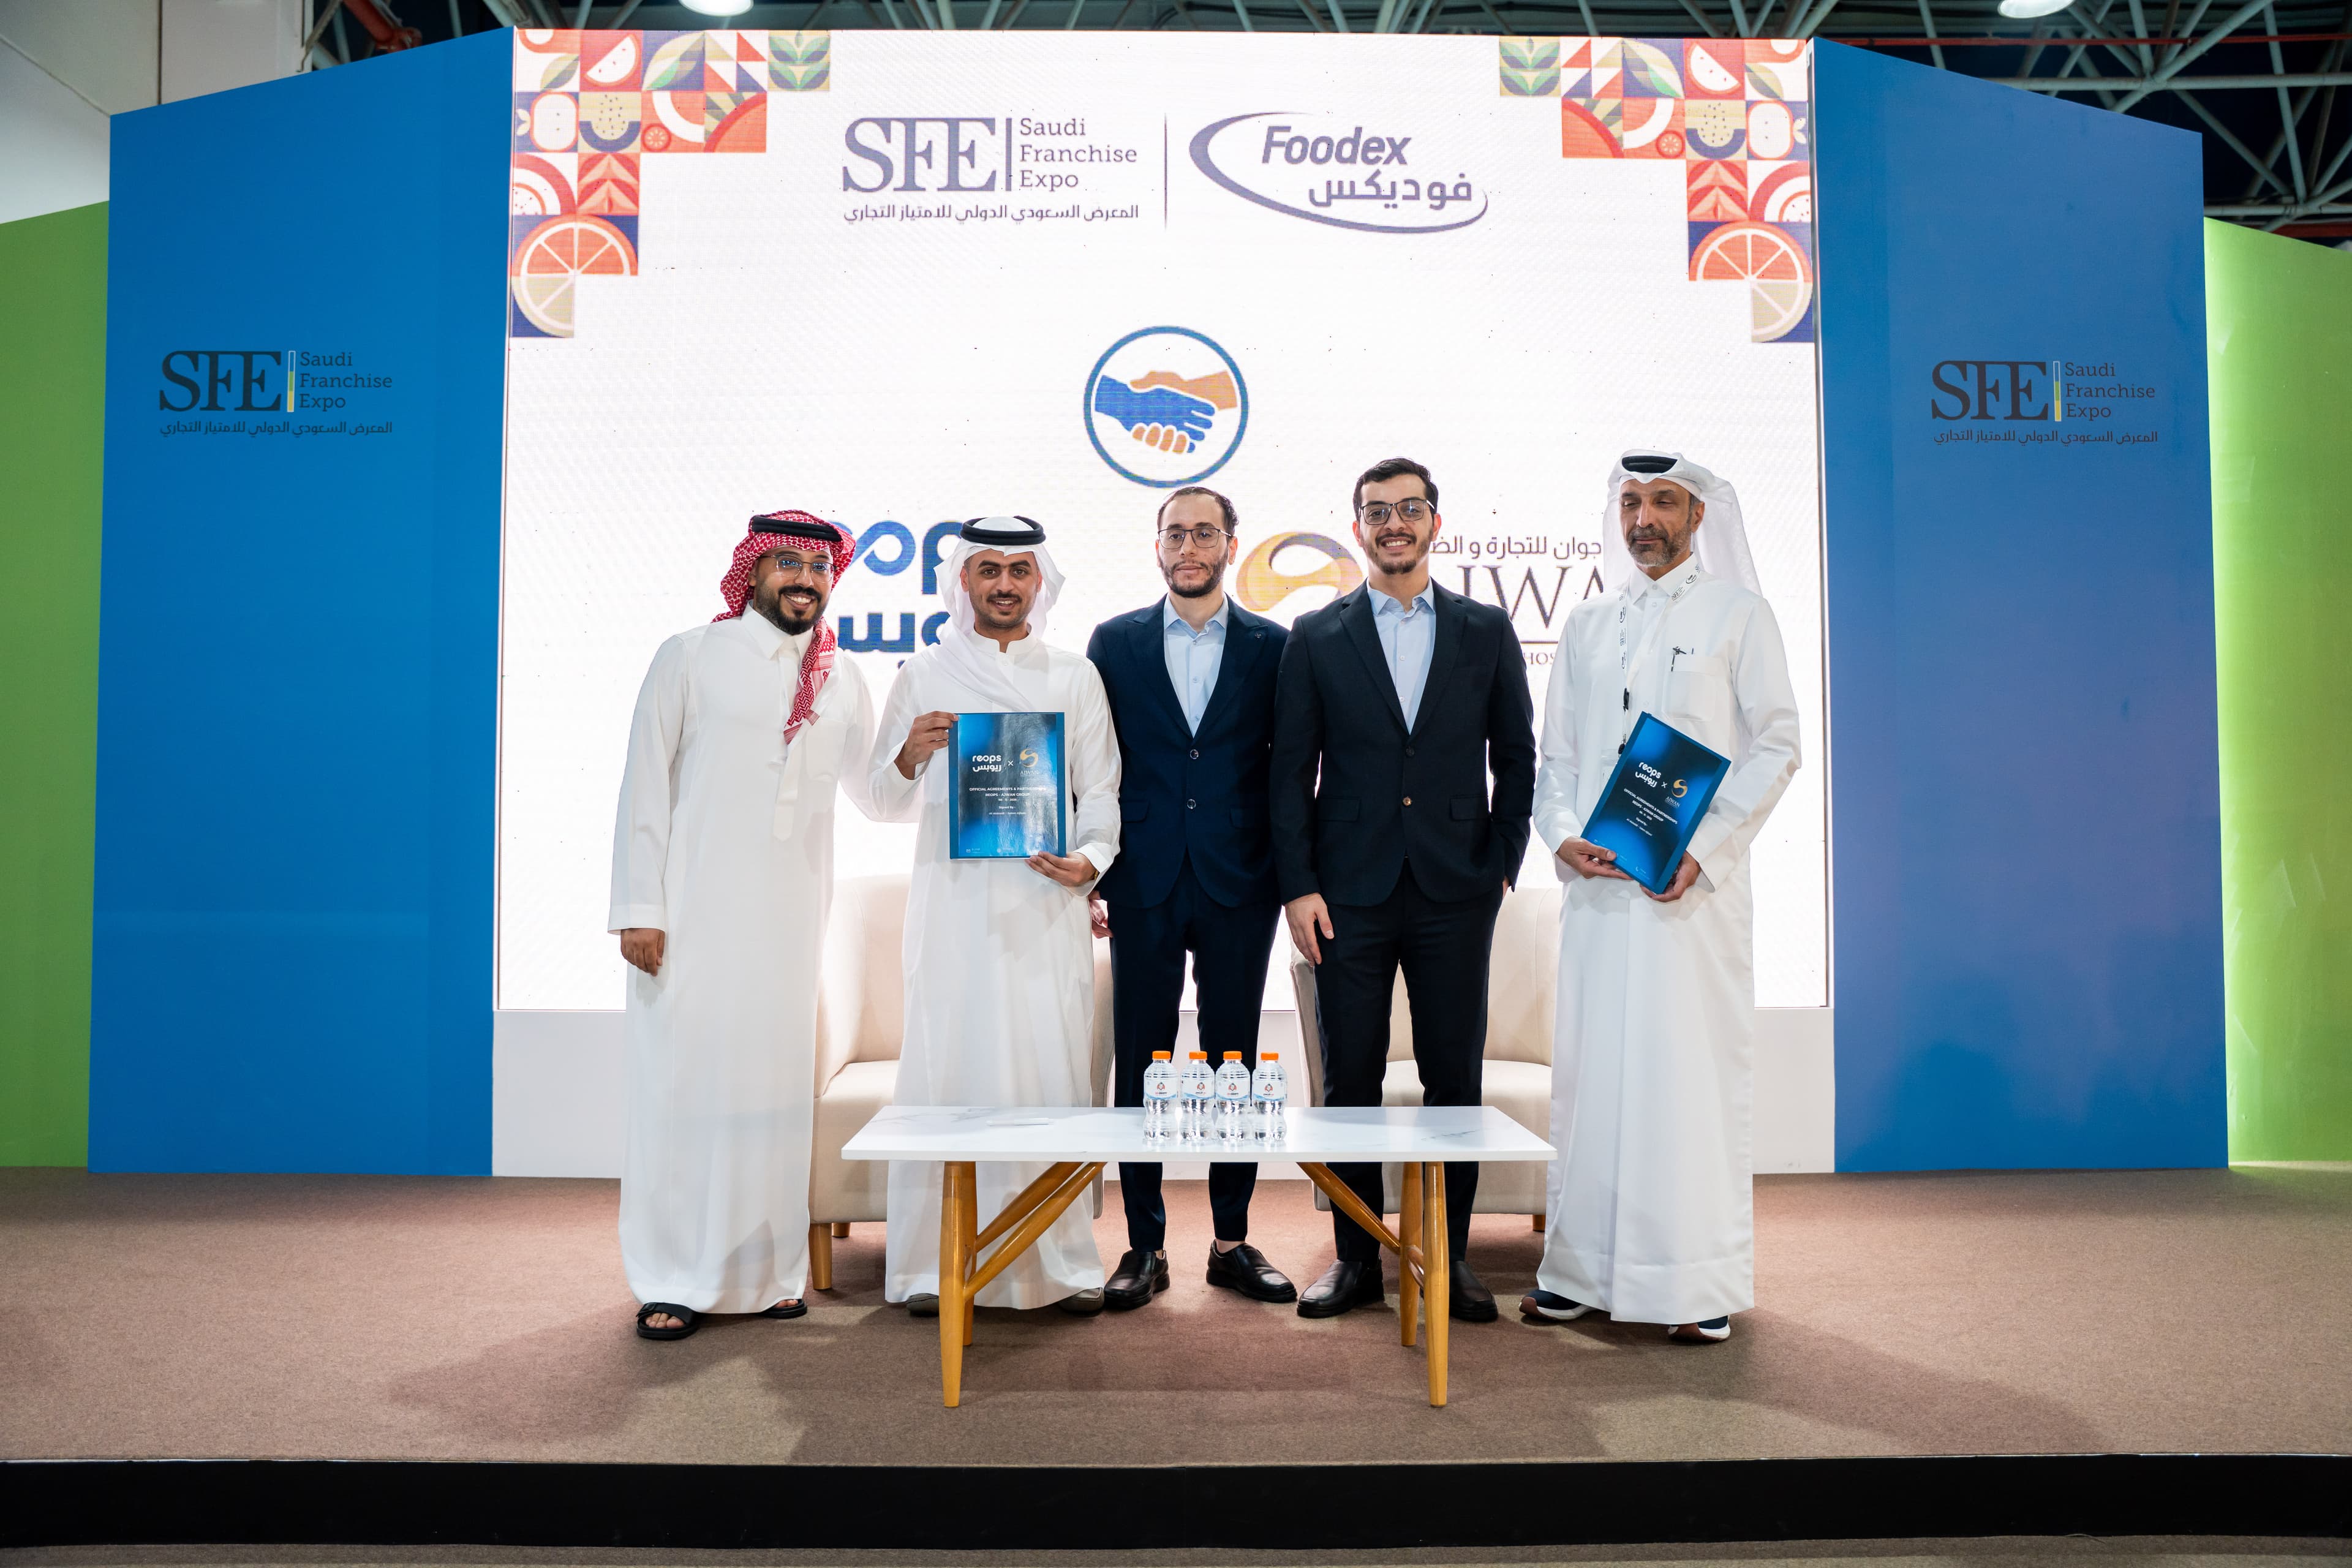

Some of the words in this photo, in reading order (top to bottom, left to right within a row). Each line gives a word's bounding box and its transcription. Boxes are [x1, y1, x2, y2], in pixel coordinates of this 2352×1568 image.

[1020, 118, 1086, 135] Saudi
[1020, 144, 1137, 162] Franchise
[1262, 126, 1412, 165] Foodex
[843, 117, 997, 192] SFE
[1020, 170, 1079, 192] Expo
[1308, 168, 1472, 211] فوديكس
[843, 204, 895, 224] التجاري
[899, 204, 952, 222] للامتياز
[955, 204, 1007, 225] الدولي
[1011, 204, 1080, 225] السعودي
[1084, 204, 1139, 222] المعرض
[300, 352, 353, 366] Saudi
[2065, 362, 2116, 377] Saudi
[159, 350, 282, 412] SFE
[299, 373, 393, 388] Franchise
[1931, 360, 2049, 420] SFE
[2065, 383, 2156, 398] Franchise
[299, 394, 346, 412] Expo
[2066, 403, 2112, 421] Expo
[159, 421, 202, 437] التجاري
[204, 421, 246, 435] للامتياز
[247, 421, 290, 438] الدولي
[292, 421, 347, 438] السعودي
[349, 421, 393, 435] المعرض
[1975, 429, 2016, 444] للامتياز
[1933, 429, 1973, 445] التجاري
[2018, 430, 2058, 447] الدولي
[2060, 431, 2113, 447] السعودي
[2116, 431, 2158, 445] المعرض
[1469, 541, 1480, 559] و
[1487, 535, 1547, 559] للتجارة
[1554, 536, 1602, 560] جوان
[972, 755, 1002, 764] reops
[1638, 762, 1662, 778] reops
[1635, 772, 1657, 788] ريوبس
